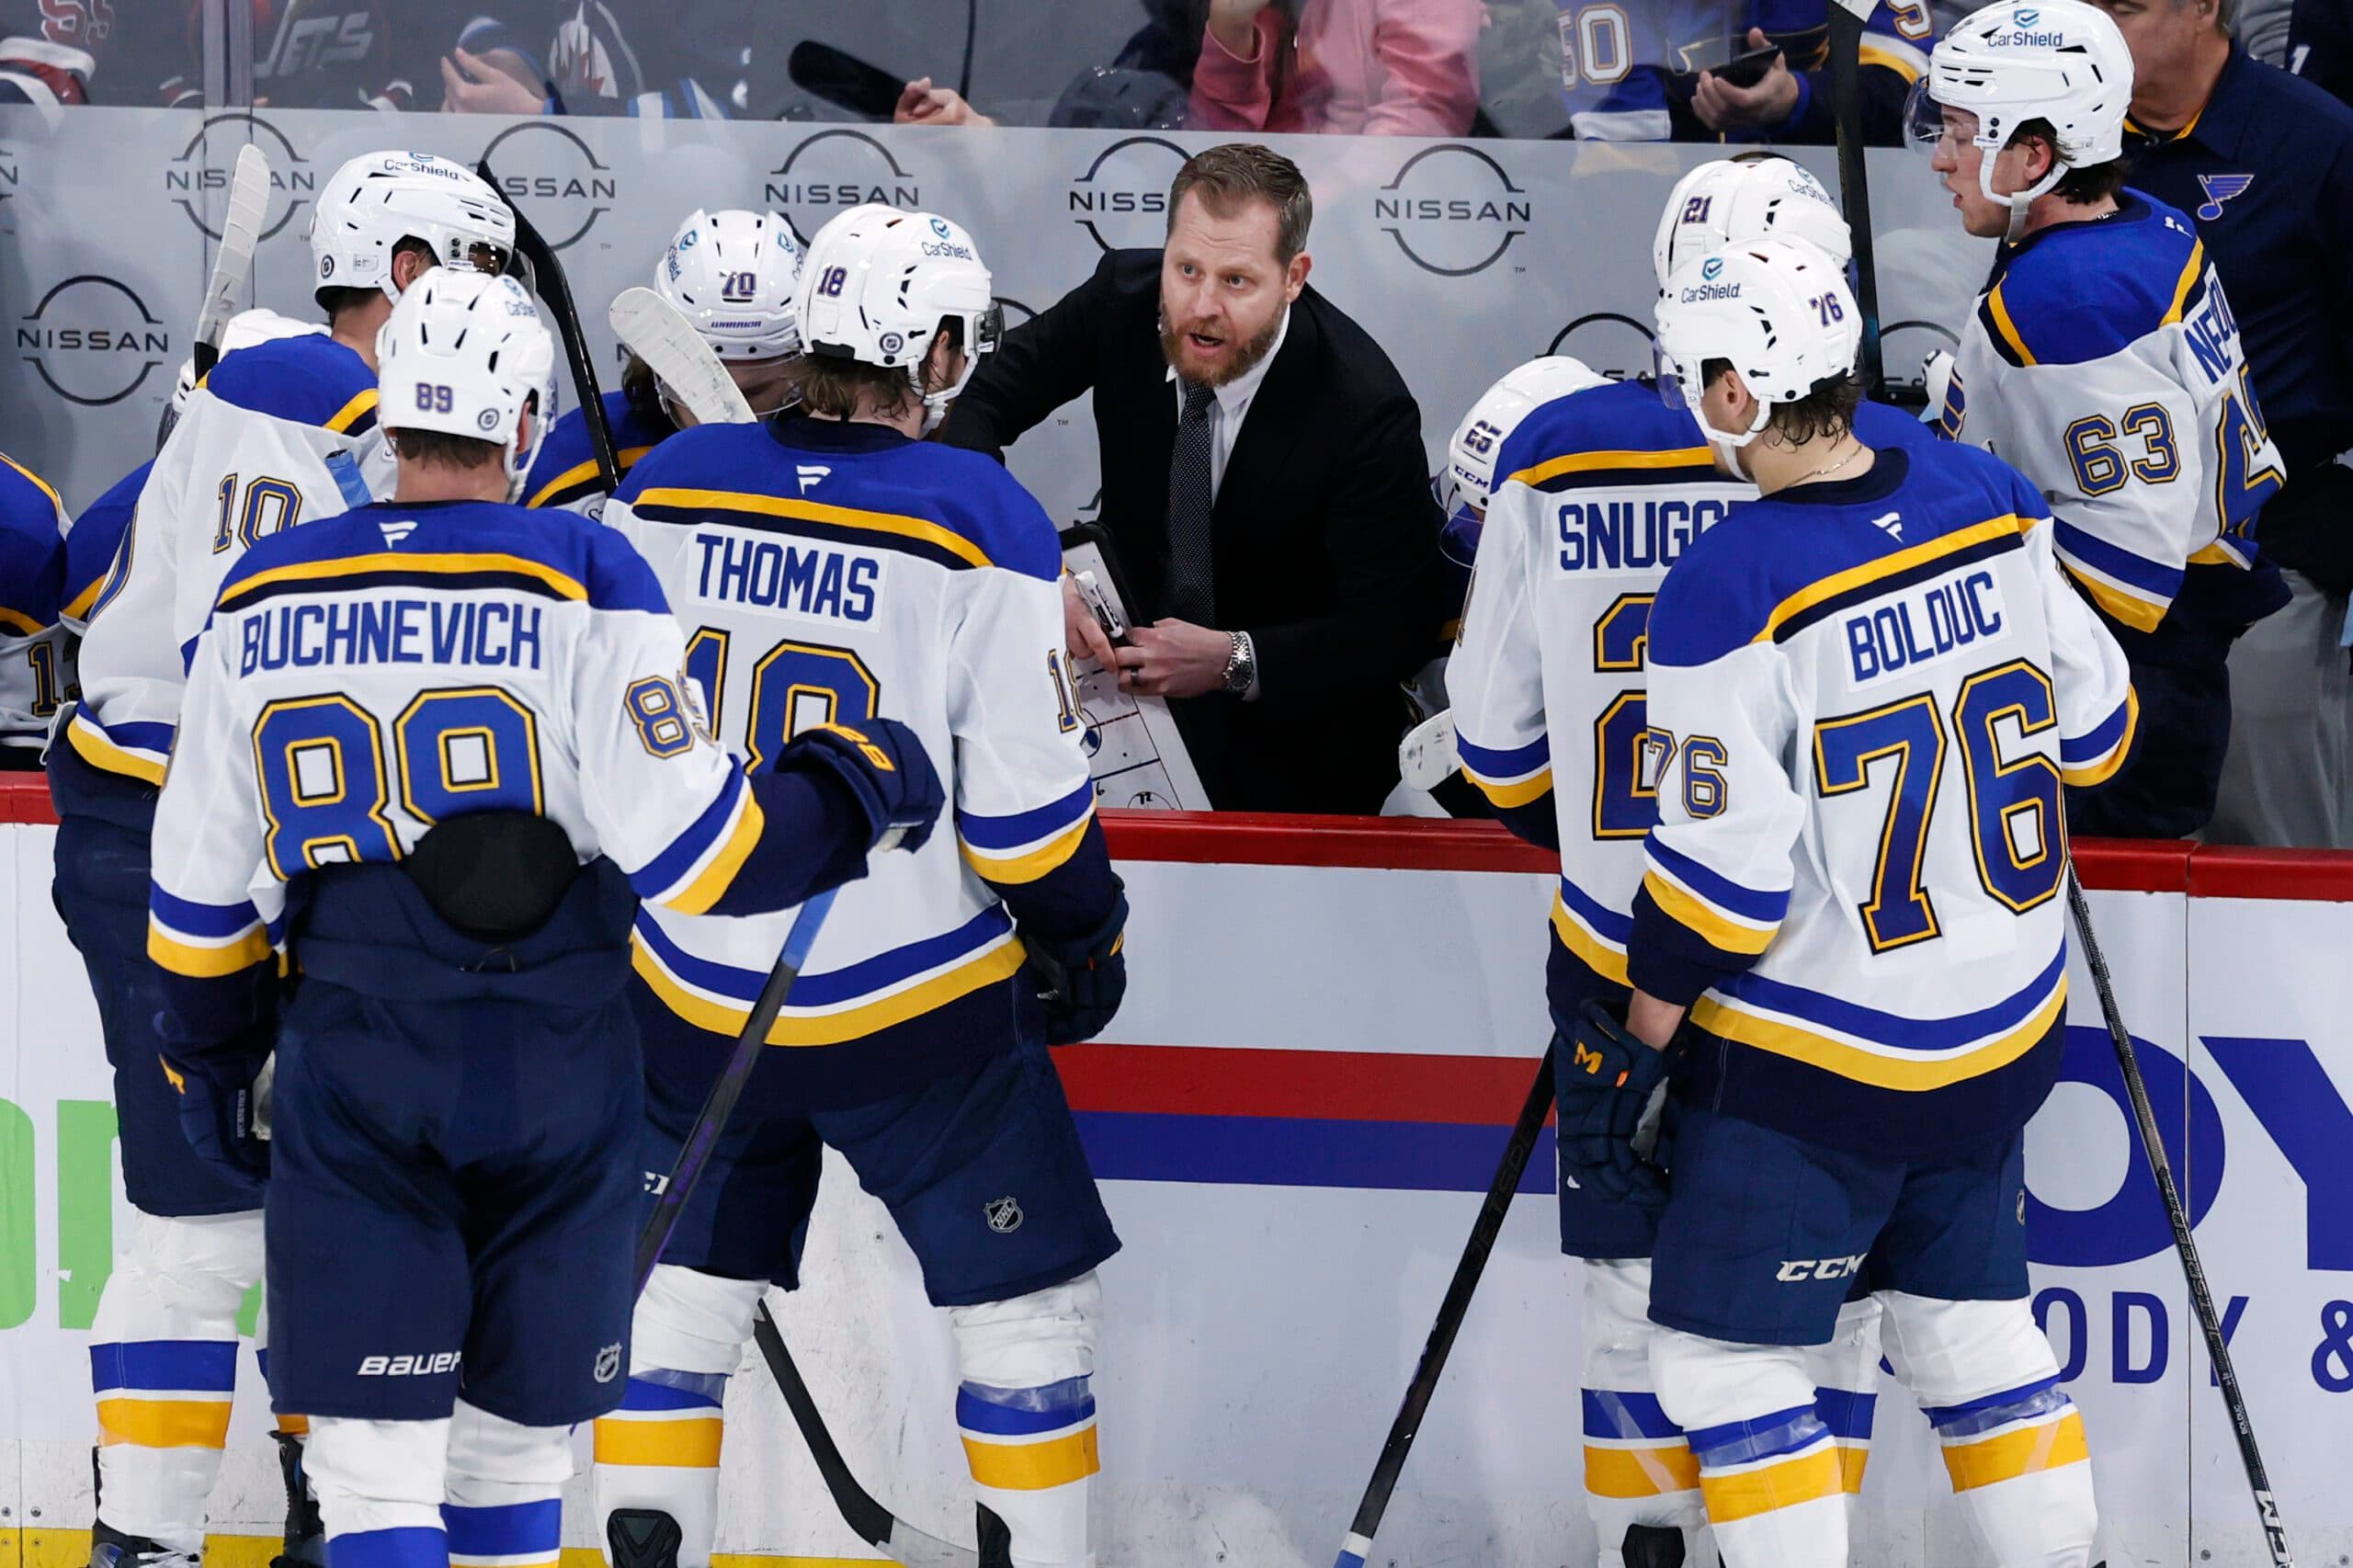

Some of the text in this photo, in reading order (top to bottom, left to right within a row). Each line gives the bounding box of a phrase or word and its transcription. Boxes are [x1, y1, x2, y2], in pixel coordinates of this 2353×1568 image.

[1987, 31, 2063, 48] CarShield
[166, 170, 314, 191] NISAN
[493, 176, 616, 199] SSAN
[765, 183, 919, 207] NISSAN
[1069, 190, 1165, 212] NISS
[1375, 199, 1530, 222] NISSAN
[1682, 195, 1713, 225] 21
[921, 241, 972, 261] CarShield
[719, 271, 757, 297] 70
[816, 264, 848, 299] 18
[1681, 283, 1742, 303] CarShield
[710, 321, 763, 329] WARRIOR
[1808, 291, 1845, 328] 76
[17, 328, 168, 353] NISSAN
[415, 381, 454, 415] 89
[2063, 402, 2182, 497] 63
[1453, 463, 1491, 489] CCM
[212, 472, 302, 555] 10
[696, 533, 879, 622] THOMAS
[240, 600, 541, 679] BUCHNEVICH
[1847, 571, 2002, 684] BOLDUC
[251, 683, 546, 882] 89
[1647, 725, 1728, 821] 76
[1813, 656, 2072, 956] 76
[2024, 1024, 2353, 1271] OY
[1775, 1252, 1869, 1282] CCM
[2031, 1287, 2353, 1393] ODY &
[2253, 1489, 2296, 1568] CM
